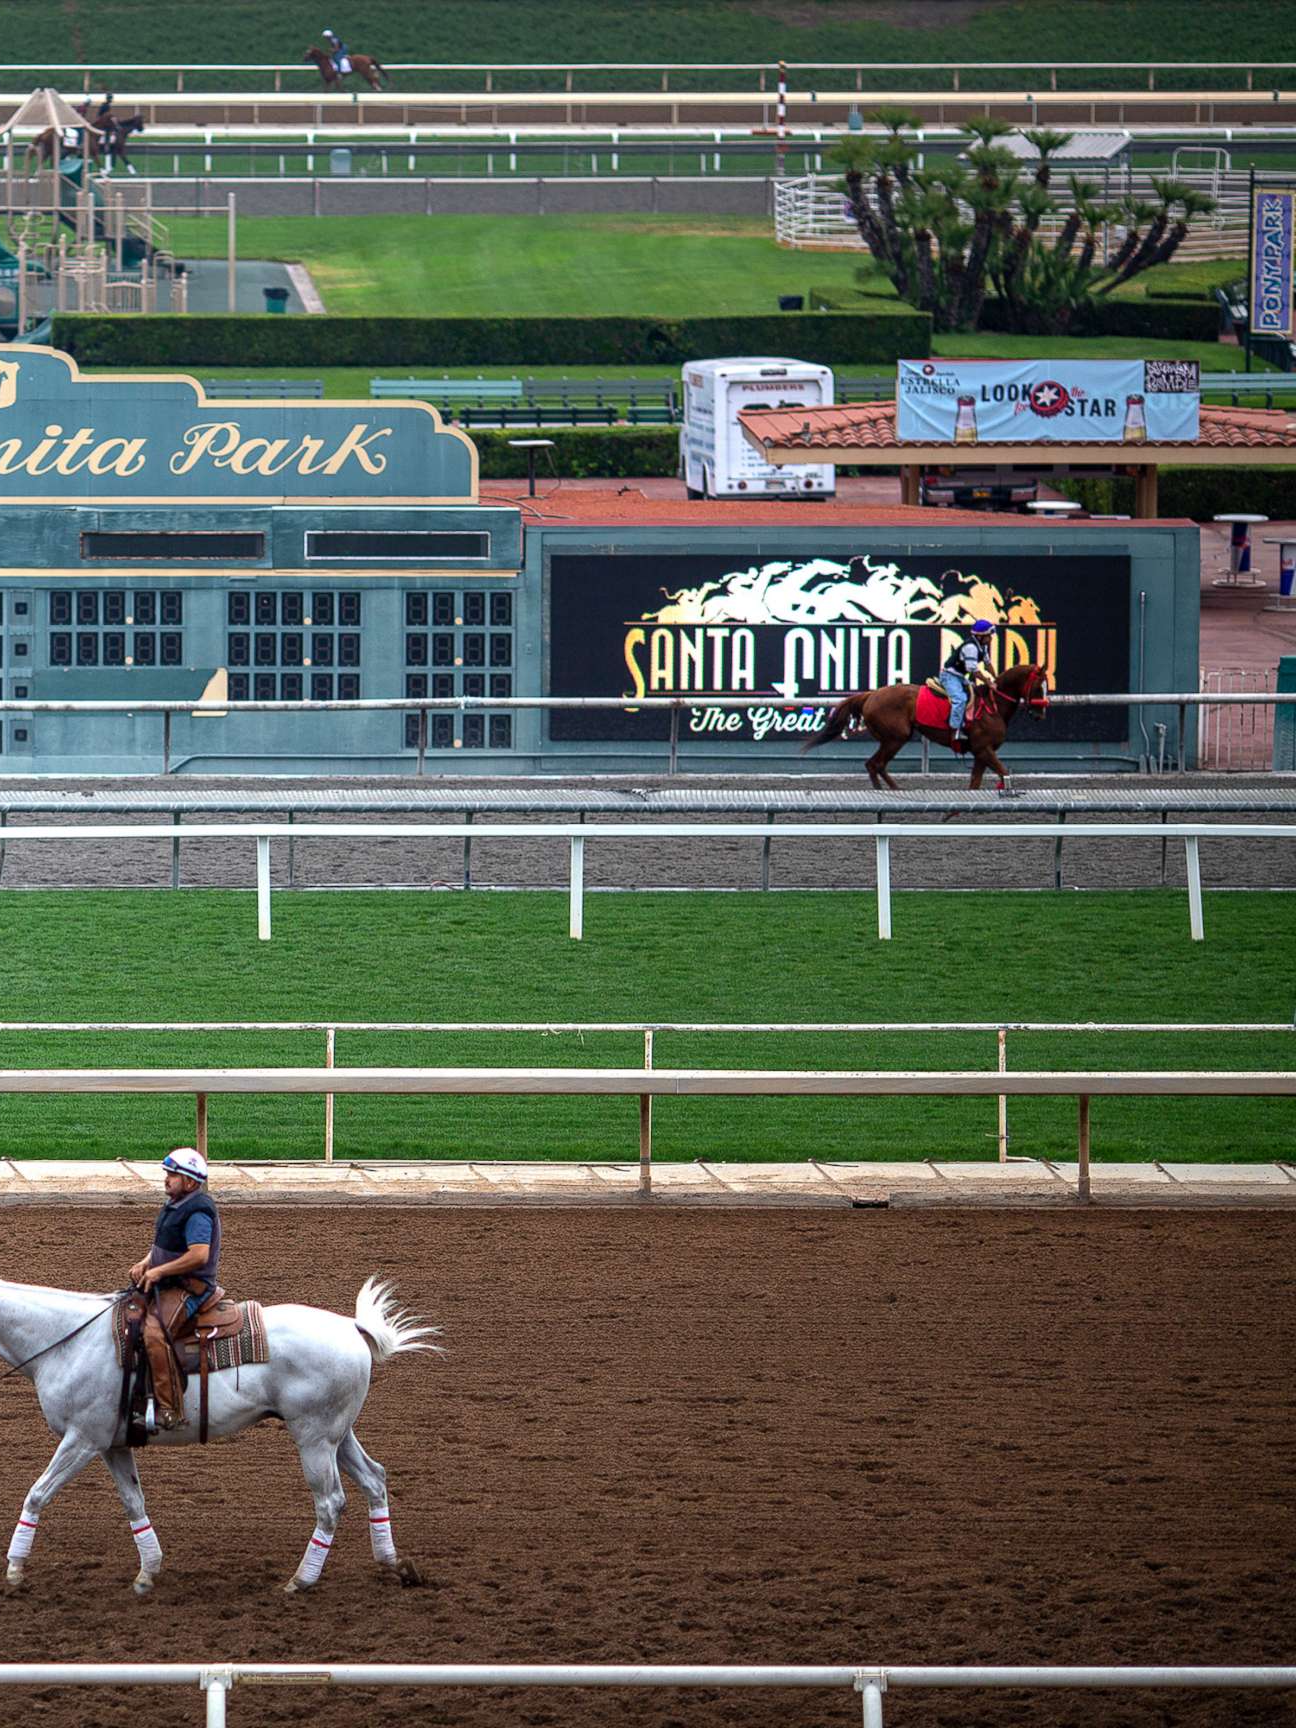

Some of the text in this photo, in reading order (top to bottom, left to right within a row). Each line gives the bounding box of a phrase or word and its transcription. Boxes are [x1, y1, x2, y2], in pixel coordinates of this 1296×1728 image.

[905, 385, 956, 395] JALISCO
[981, 383, 1033, 402] LOOK
[1064, 399, 1117, 417] STAR
[622, 627, 755, 708] SANTA
[772, 627, 911, 705] ANITA
[690, 706, 743, 732] The
[747, 706, 826, 741] Great
